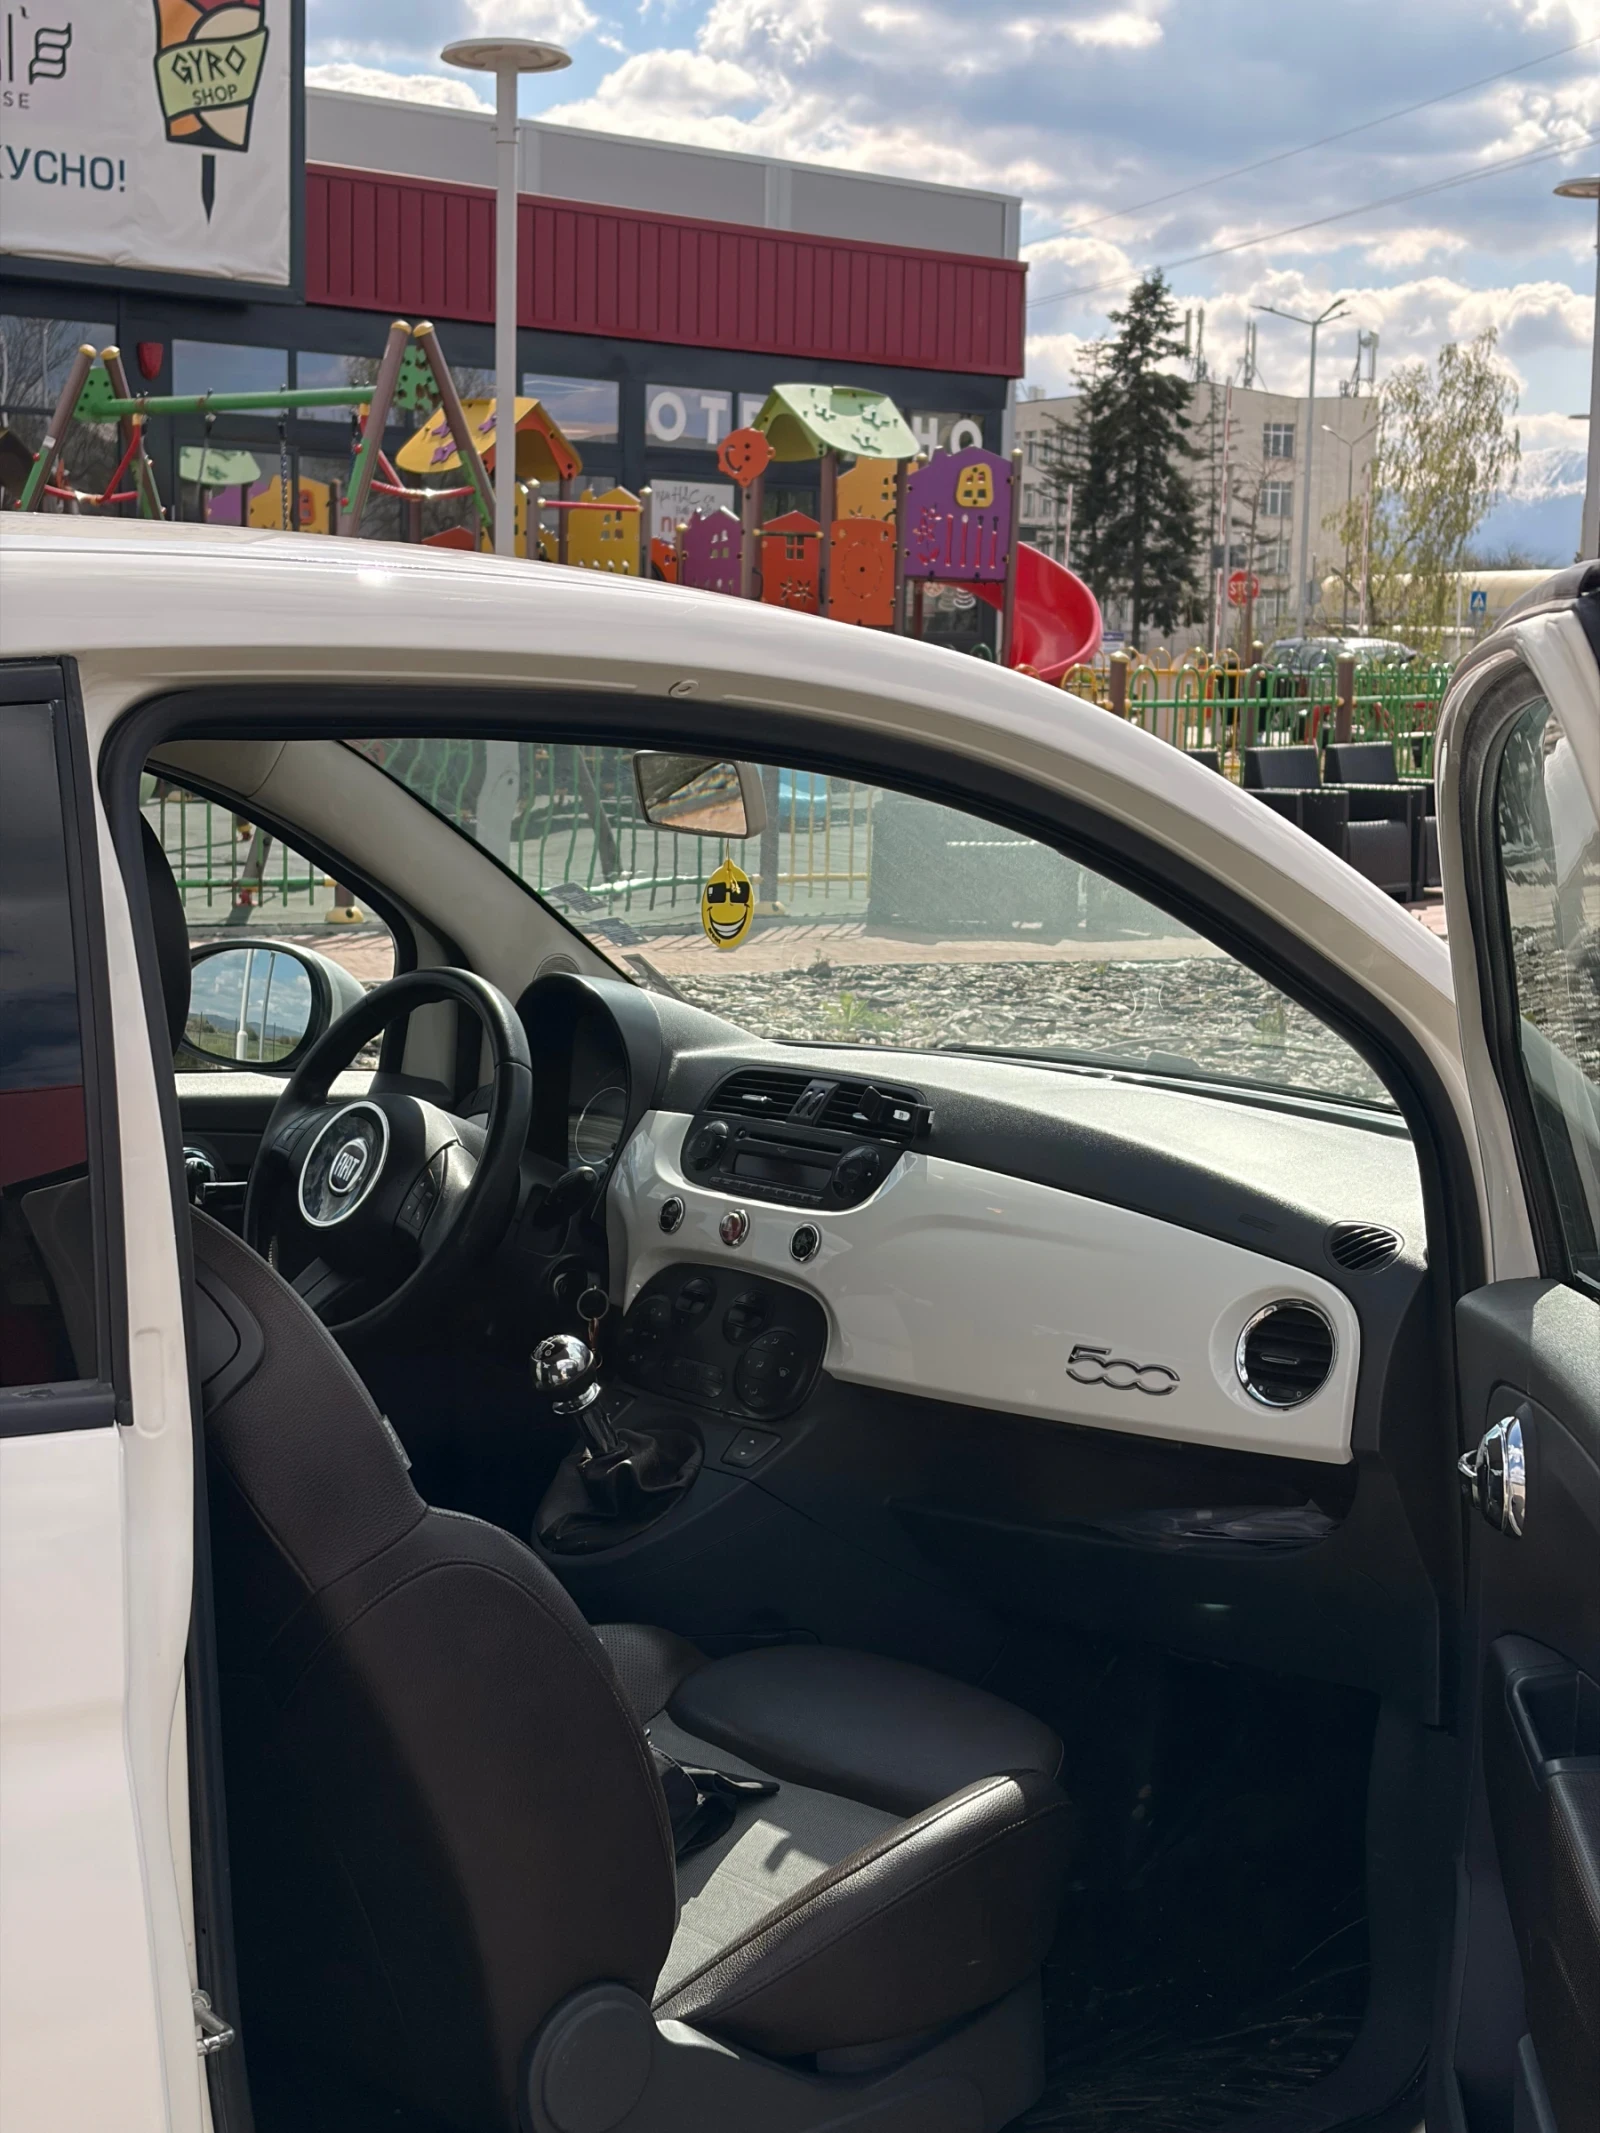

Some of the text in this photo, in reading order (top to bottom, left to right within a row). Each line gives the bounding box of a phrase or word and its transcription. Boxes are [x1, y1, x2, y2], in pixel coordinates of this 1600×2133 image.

[171, 44, 247, 85] GYRO
[192, 83, 238, 105] SHOP
[0, 144, 125, 193] УСНО!
[333, 1152, 361, 1182] FIAT
[1065, 1343, 1181, 1396] 500
